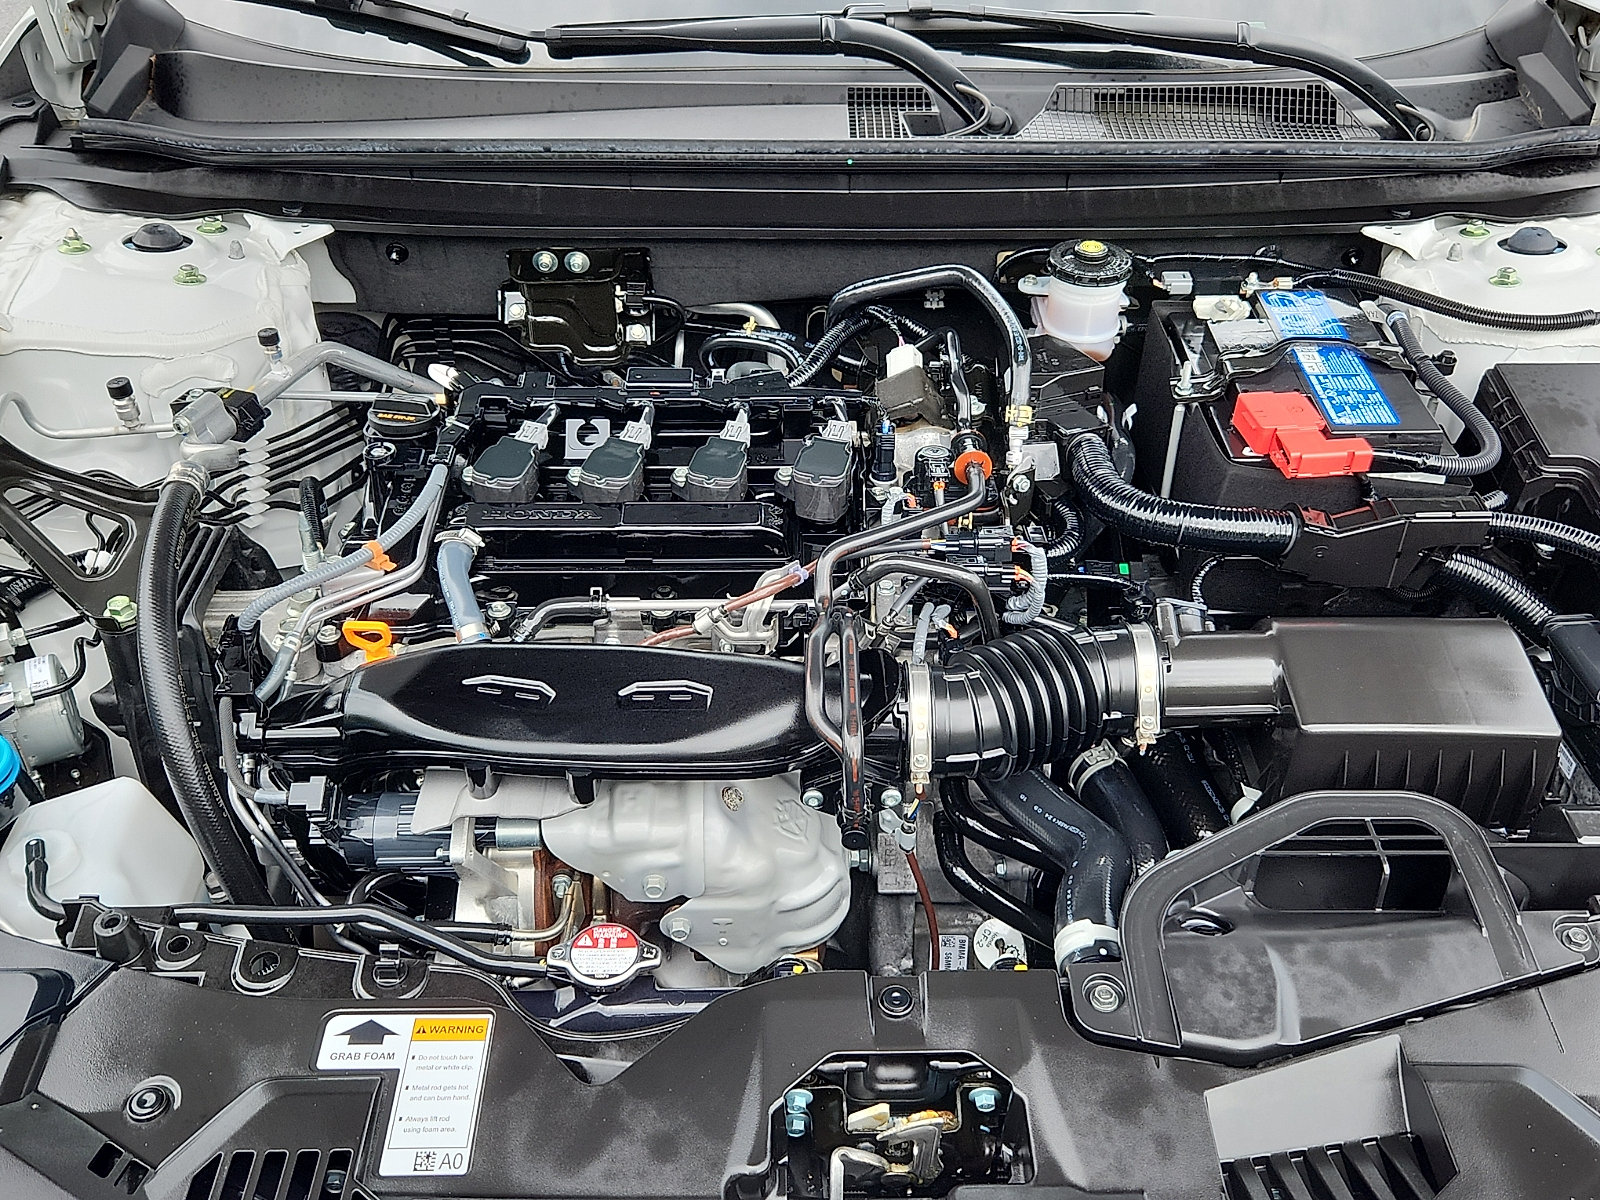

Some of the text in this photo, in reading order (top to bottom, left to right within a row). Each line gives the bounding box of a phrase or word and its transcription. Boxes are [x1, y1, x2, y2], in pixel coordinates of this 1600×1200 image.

[481, 509, 602, 520] HONDA
[975, 927, 991, 949] CF-2
[429, 1025, 484, 1034] WARNING
[329, 1052, 395, 1061] GRAB FOAM
[438, 1153, 464, 1170] A0
